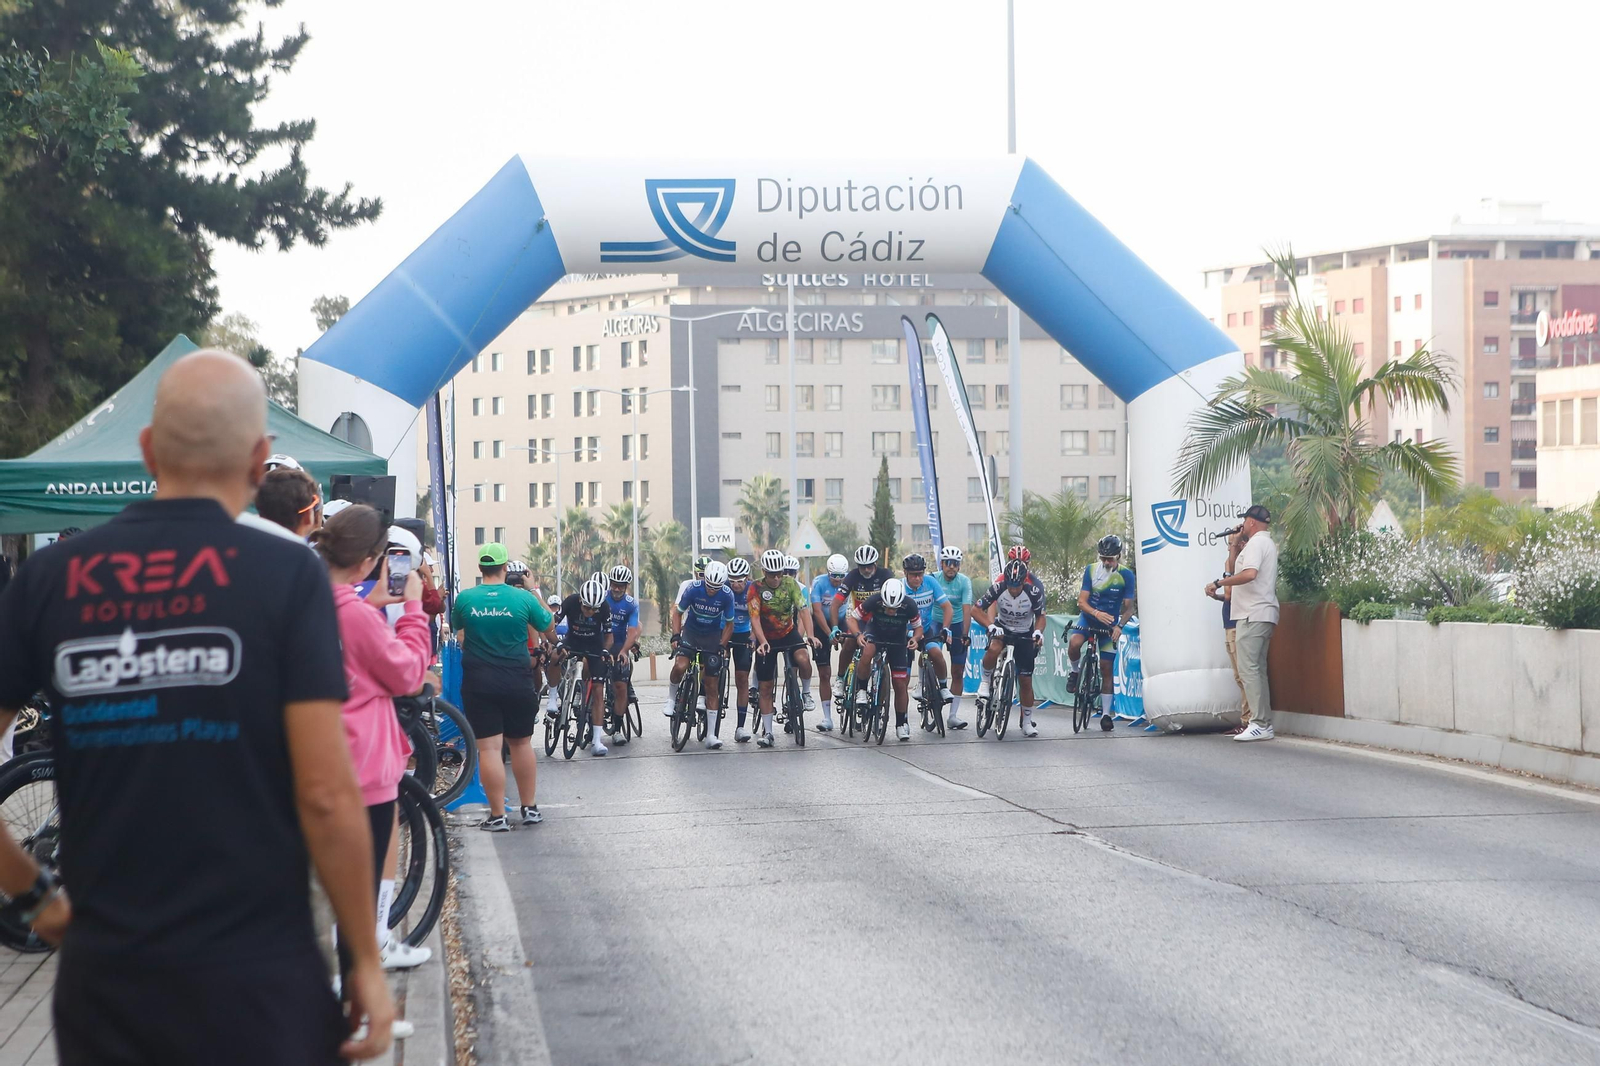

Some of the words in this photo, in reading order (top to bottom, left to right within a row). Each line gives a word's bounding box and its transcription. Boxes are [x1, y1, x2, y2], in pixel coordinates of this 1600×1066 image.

[757, 177, 963, 219] Diputación
[757, 232, 801, 262] de
[820, 231, 925, 262] Cádiz
[863, 273, 934, 287] HOTEL
[602, 315, 660, 337] ALGECIRAS
[737, 312, 864, 332] ALGECIRAS
[1549, 308, 1597, 339] vodafone
[45, 481, 158, 495] ANDALUCIA
[707, 534, 731, 543] GYM
[1198, 528, 1217, 547] de
[65, 546, 231, 600] KREA
[65, 643, 230, 688] Lagostena
